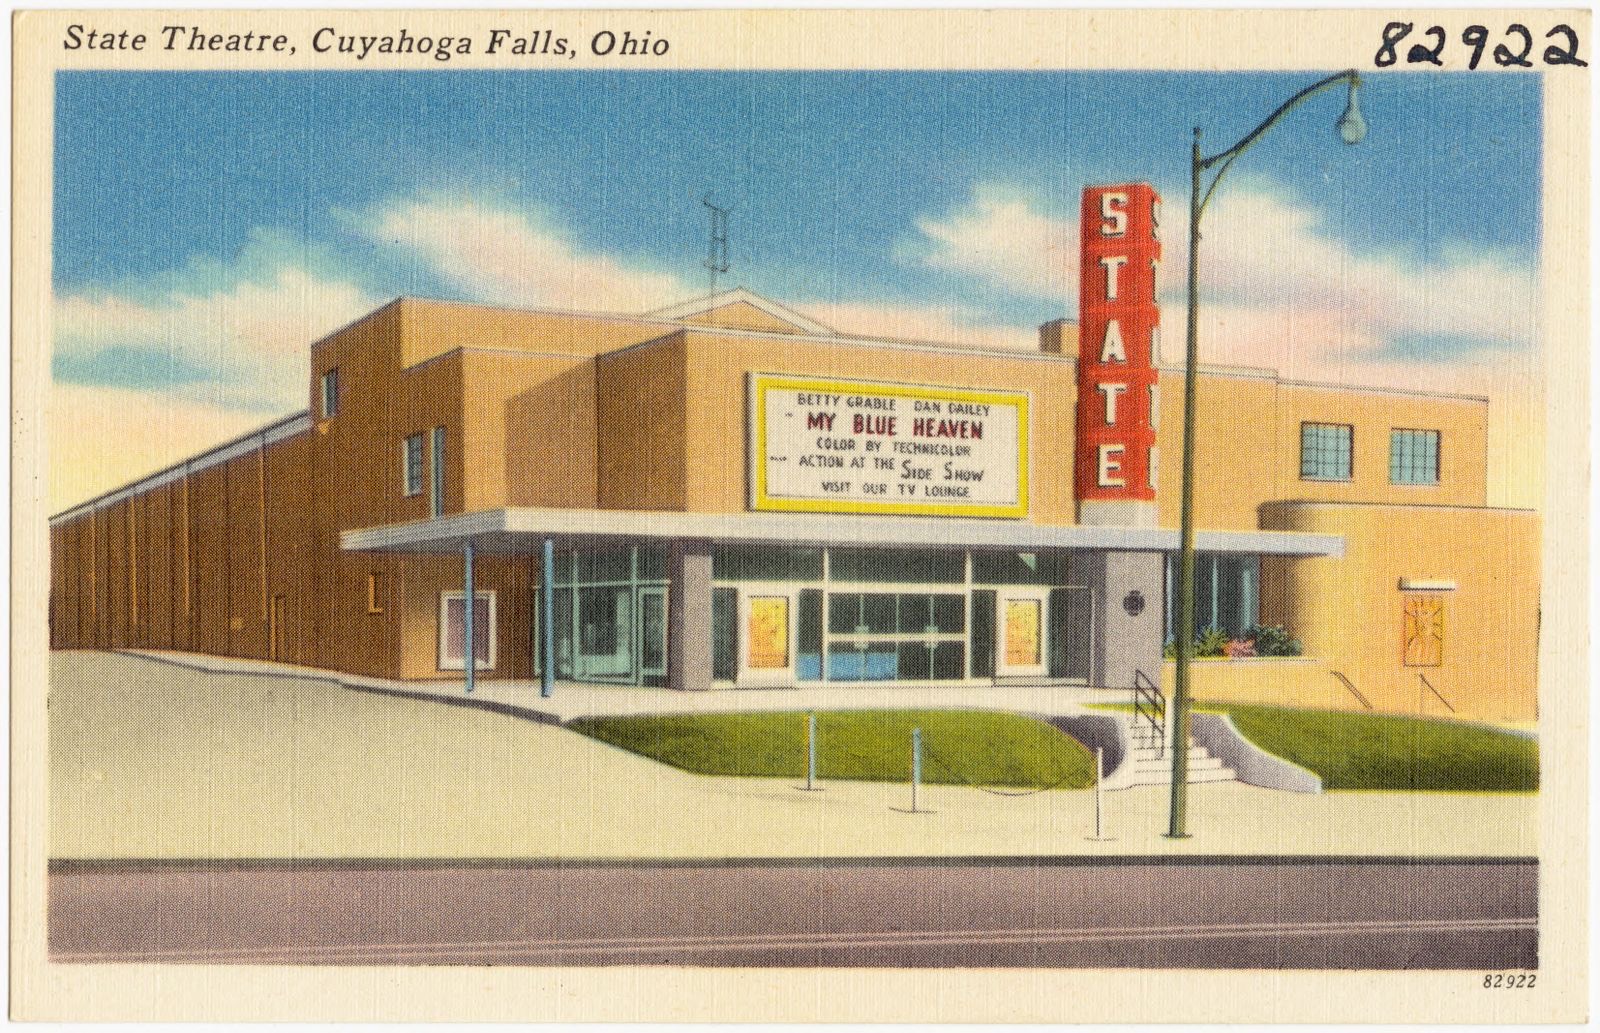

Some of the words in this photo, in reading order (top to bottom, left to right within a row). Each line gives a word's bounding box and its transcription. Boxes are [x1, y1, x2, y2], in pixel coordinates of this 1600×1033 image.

[63, 24, 147, 51] State
[161, 25, 297, 55] Theatre,
[312, 27, 472, 62] Cuyahoga
[484, 29, 577, 60] Falls,
[591, 30, 670, 56] Ohio
[1374, 21, 1589, 71] 82922
[1097, 191, 1129, 489] STATE
[797, 393, 840, 406] BETTY
[846, 396, 896, 411] GRABLE
[914, 400, 941, 413] DAN
[948, 402, 990, 416] DAILEY
[807, 411, 837, 432] MY
[852, 413, 897, 436] BLUE
[912, 417, 983, 440] HEAVEN
[816, 436, 856, 451] COLOR
[865, 440, 882, 452] BY
[892, 441, 972, 456] TECHNICOLOR
[799, 454, 844, 469] ACTION
[850, 457, 866, 469] AT
[873, 457, 895, 470] THE
[821, 481, 852, 493] VISIT
[863, 483, 888, 495] OUR
[897, 483, 916, 496] TV
[924, 485, 971, 498] LOUNGE
[1483, 974, 1537, 989] 82922
